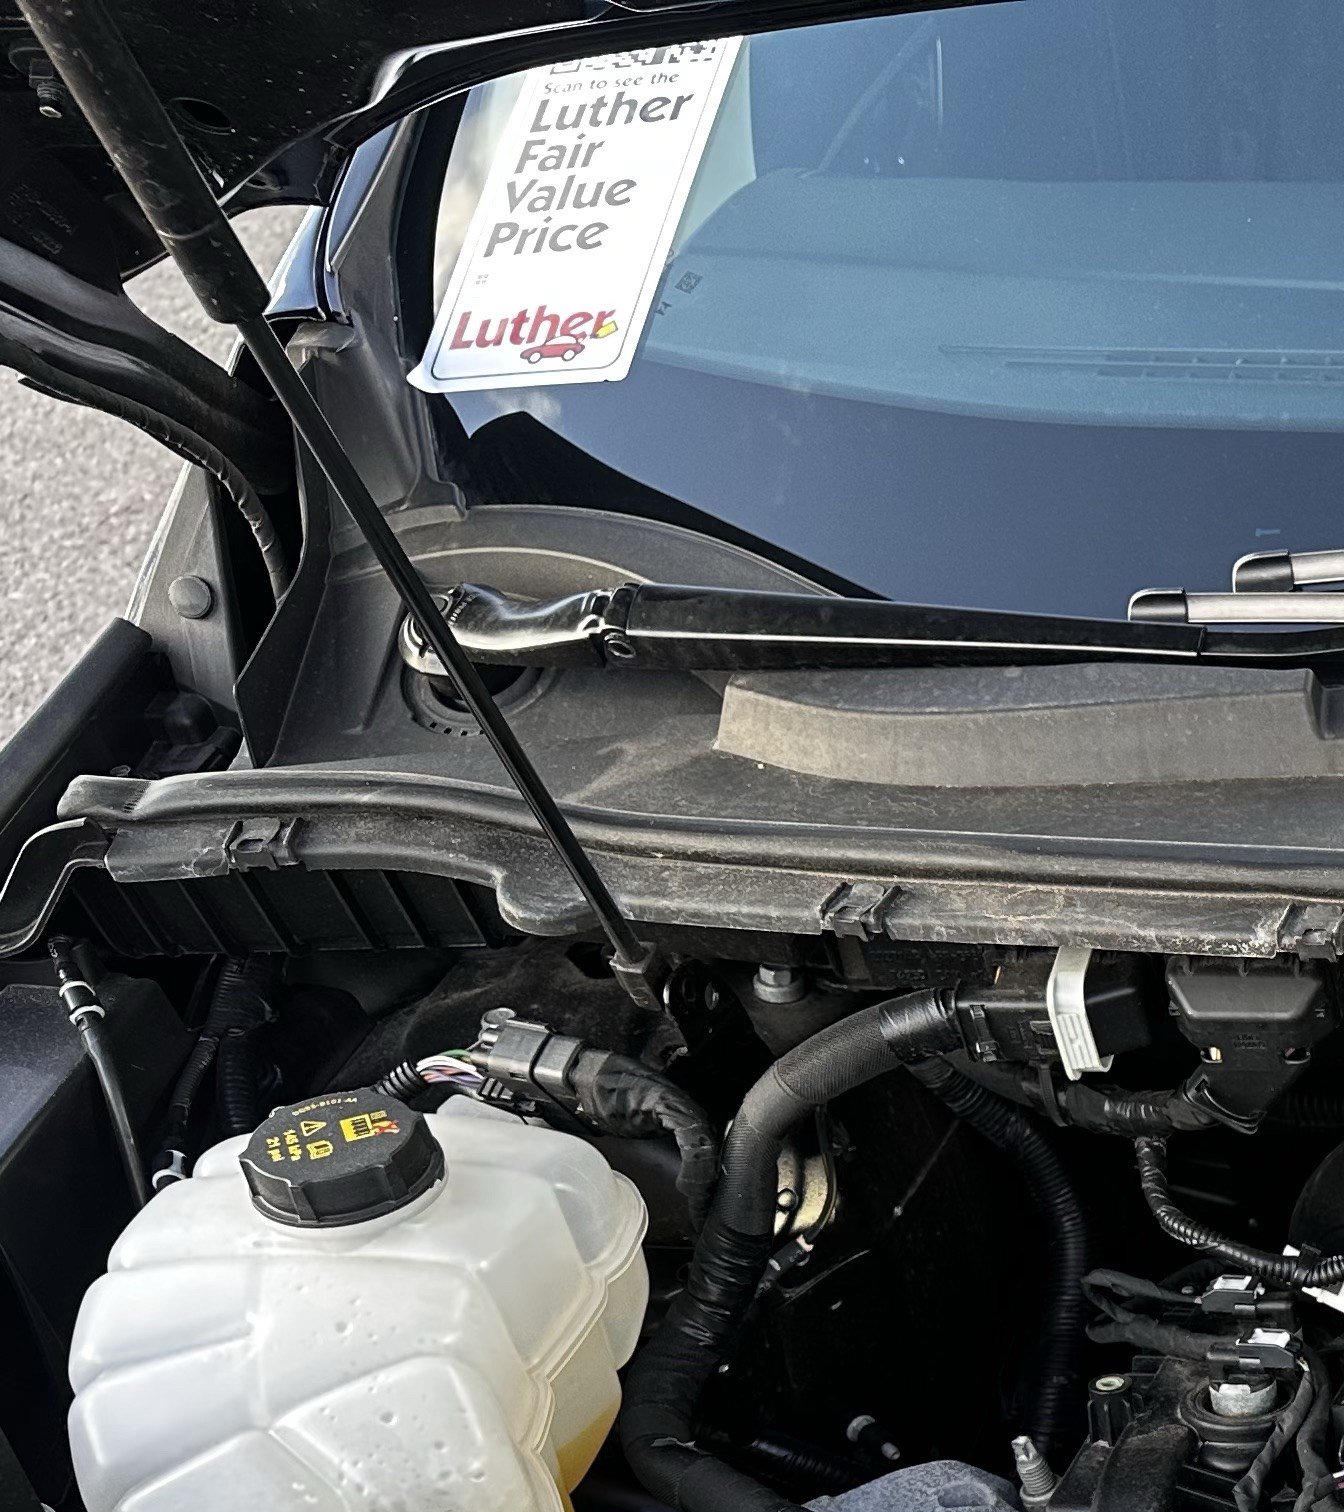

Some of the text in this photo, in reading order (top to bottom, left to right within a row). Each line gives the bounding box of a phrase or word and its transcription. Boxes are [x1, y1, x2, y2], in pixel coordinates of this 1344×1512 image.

[544, 70, 680, 96] Scan to see the
[529, 91, 695, 133] Luther
[514, 133, 605, 174] Fair
[505, 174, 637, 214] Value
[483, 216, 609, 258] Price
[449, 305, 617, 351] Luther
